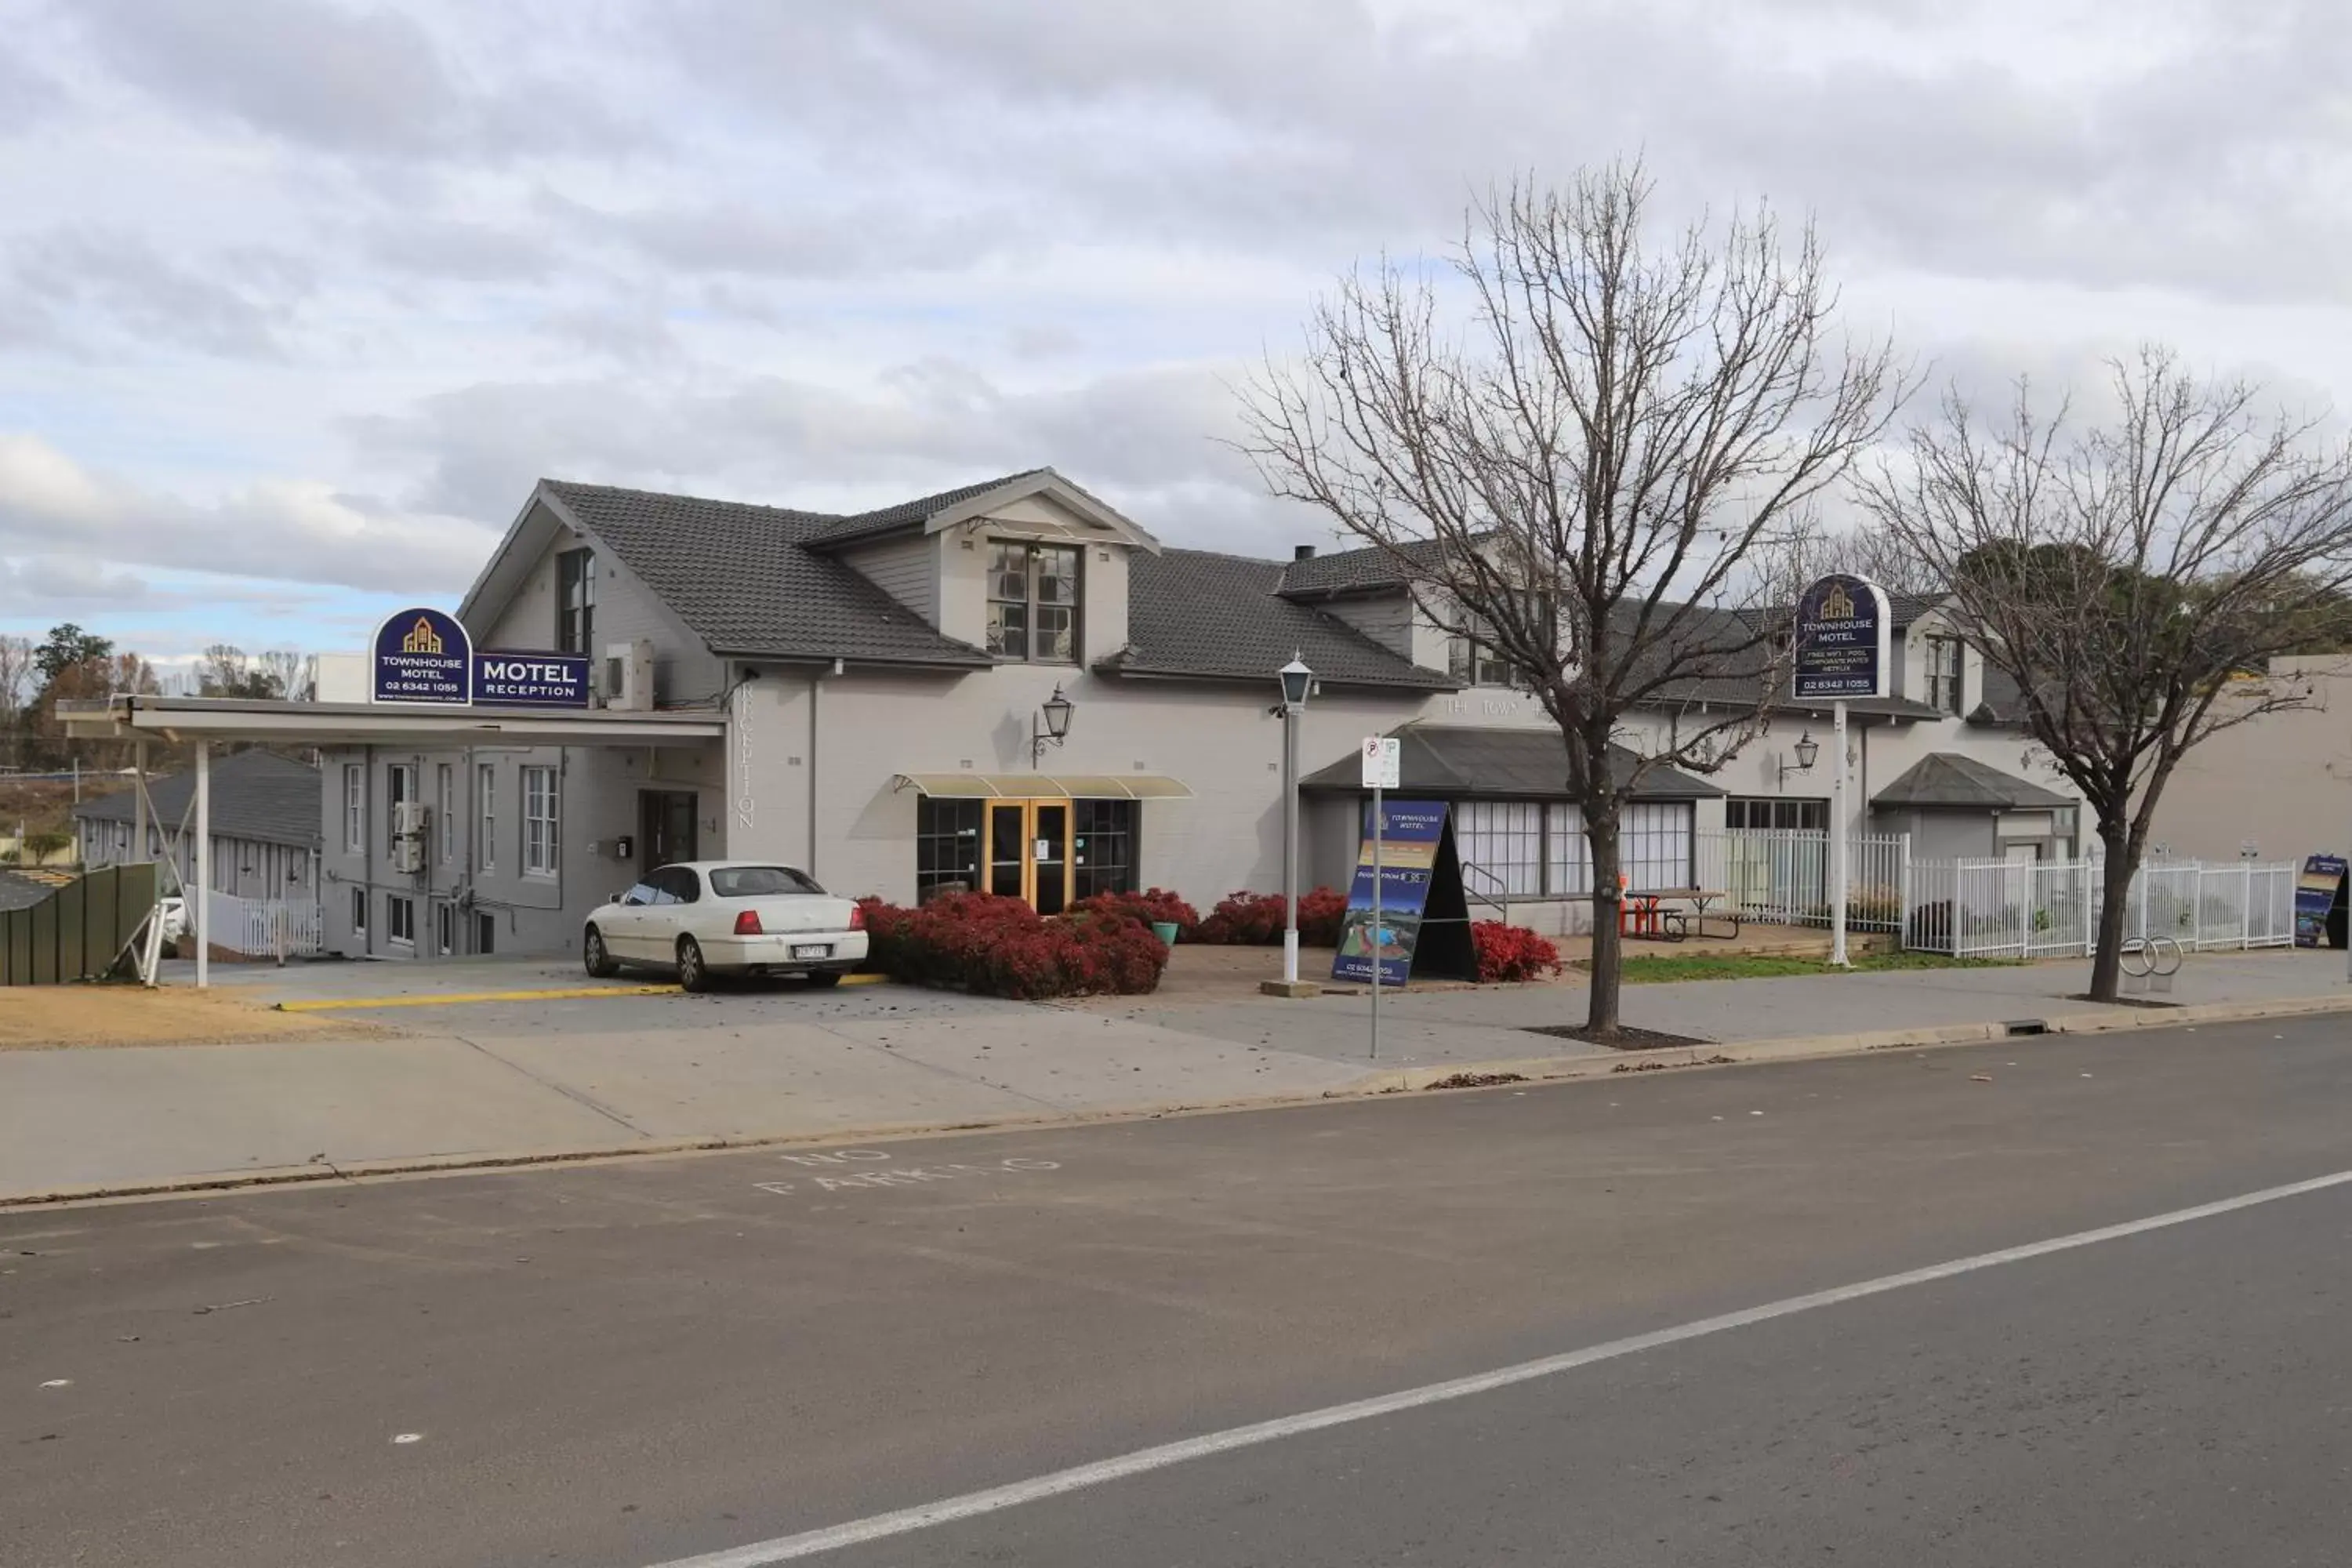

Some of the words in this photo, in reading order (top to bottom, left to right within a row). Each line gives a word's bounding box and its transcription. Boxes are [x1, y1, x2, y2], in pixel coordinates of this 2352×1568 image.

[1802, 619, 1873, 632] TOWNHOUSE
[1819, 632, 1857, 642] MOTEL
[381, 656, 463, 669] TOWNHOUSE
[401, 669, 445, 680] MOTEL
[483, 662, 578, 683] MOTEL
[386, 681, 401, 691] 02
[402, 681, 430, 691] 6342
[434, 683, 459, 692] 1055
[486, 684, 575, 697] RECEPTION
[739, 683, 753, 829] RECEPTION
[780, 1150, 891, 1166] NO
